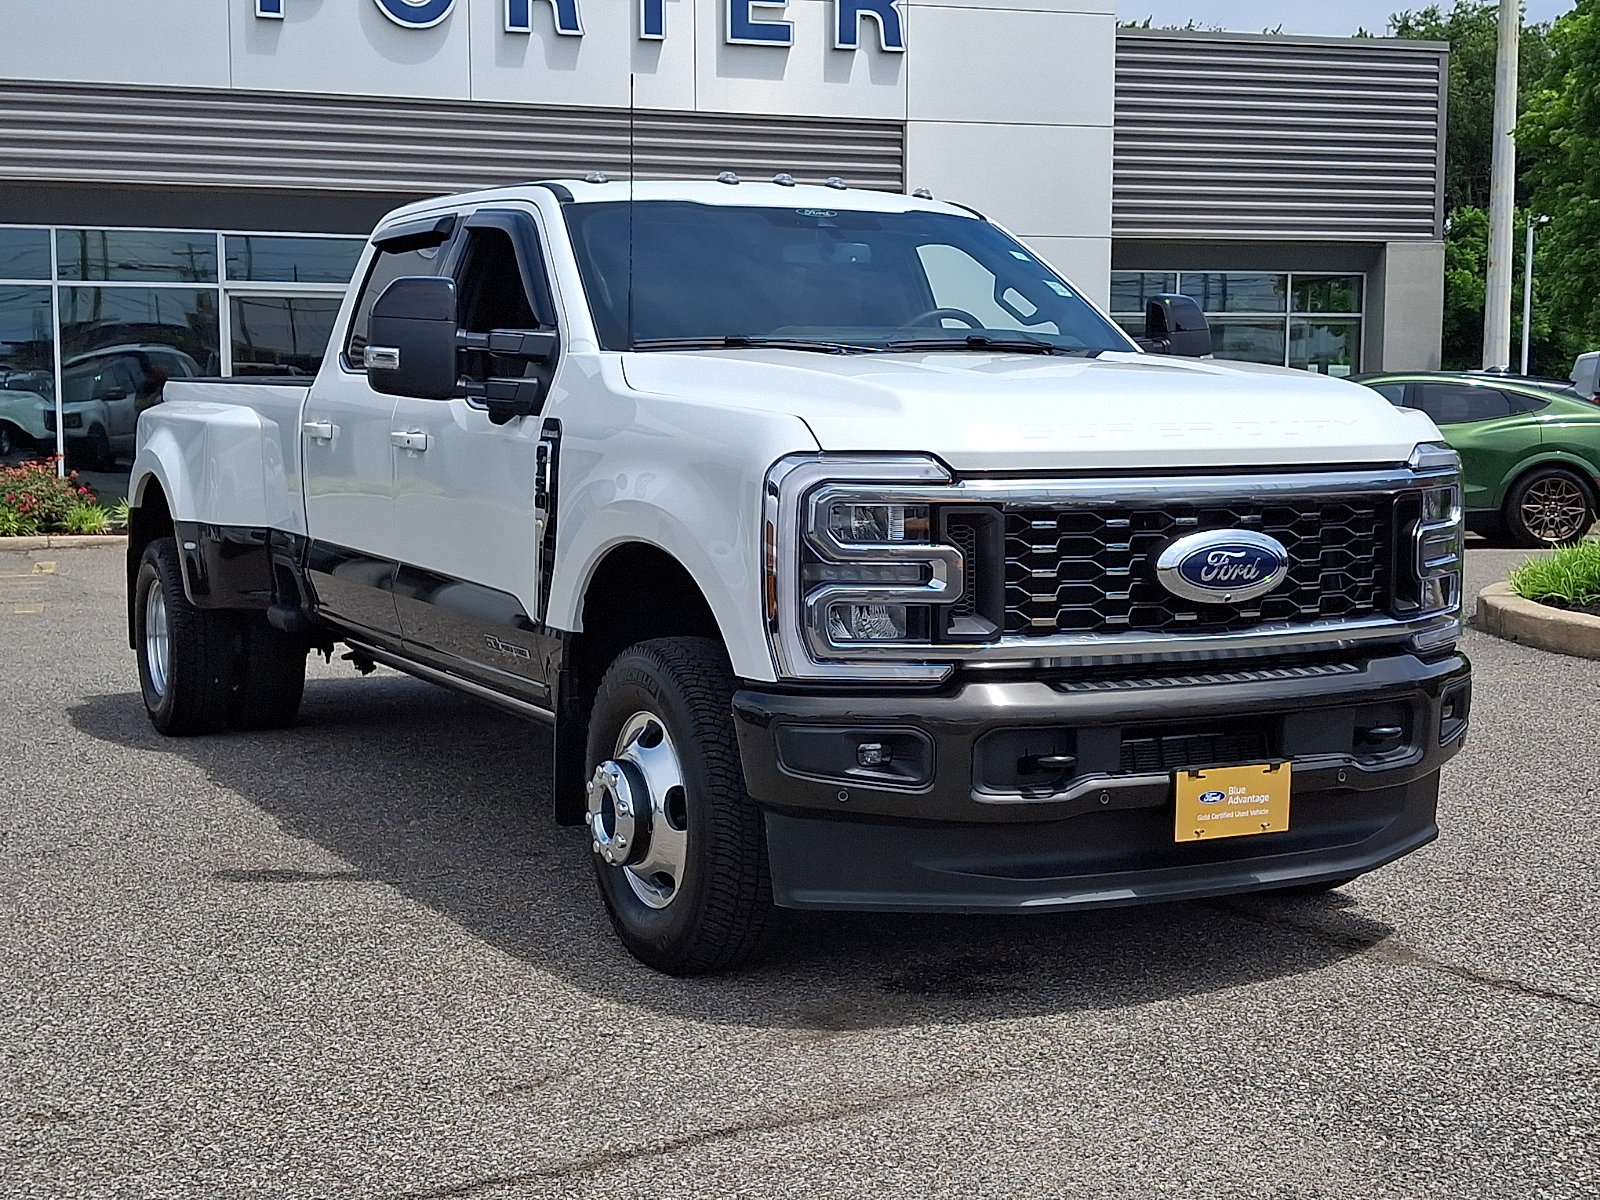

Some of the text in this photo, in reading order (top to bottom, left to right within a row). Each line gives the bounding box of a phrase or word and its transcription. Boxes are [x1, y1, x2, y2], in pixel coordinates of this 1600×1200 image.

[1200, 550, 1262, 582] Ford
[1228, 786, 1246, 795] Blue
[1227, 794, 1270, 805] Advantage
[1197, 813, 1211, 821] Gold
[1211, 811, 1234, 820] Certified
